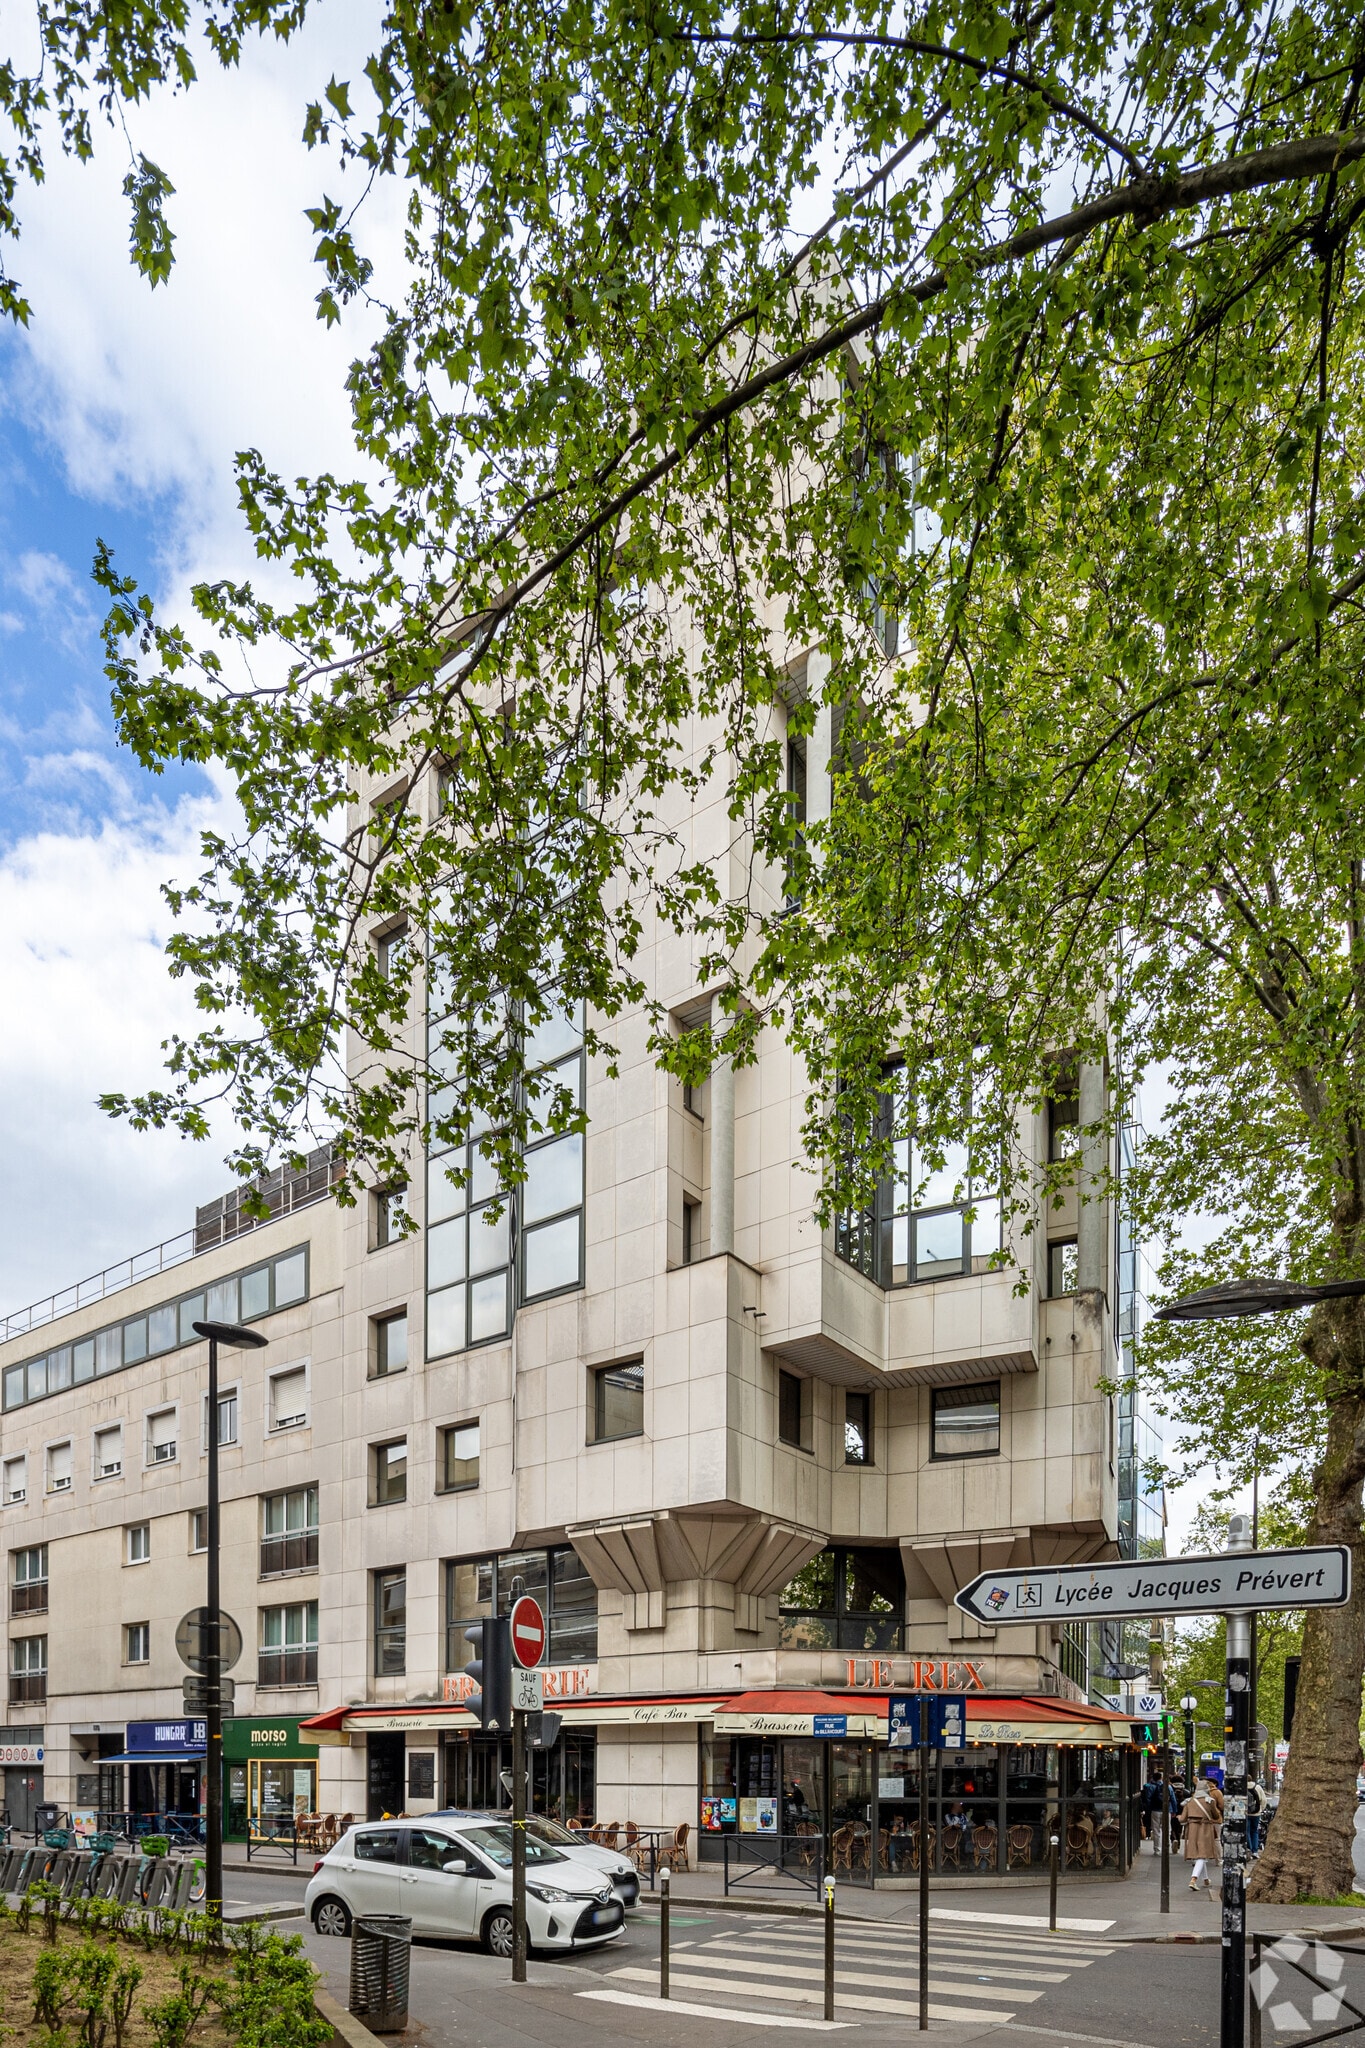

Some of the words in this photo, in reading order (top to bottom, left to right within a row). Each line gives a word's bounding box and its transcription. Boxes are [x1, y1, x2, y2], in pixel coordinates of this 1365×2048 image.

[1055, 1582, 1113, 1606] Lycée
[1128, 1577, 1222, 1600] Jacques
[1236, 1568, 1325, 1592] Prévert
[520, 1672, 537, 1682] SAUF
[845, 1658, 895, 1690] LE
[912, 1660, 986, 1691] REX
[387, 1718, 422, 1727] Brasserie
[634, 1707, 659, 1724] Café
[664, 1707, 687, 1719] Bar
[193, 1723, 206, 1739] HB
[750, 1717, 809, 1731] Brasserie
[978, 1724, 995, 1738] Le
[996, 1724, 1021, 1739] Rex
[251, 1730, 287, 1742] morso
